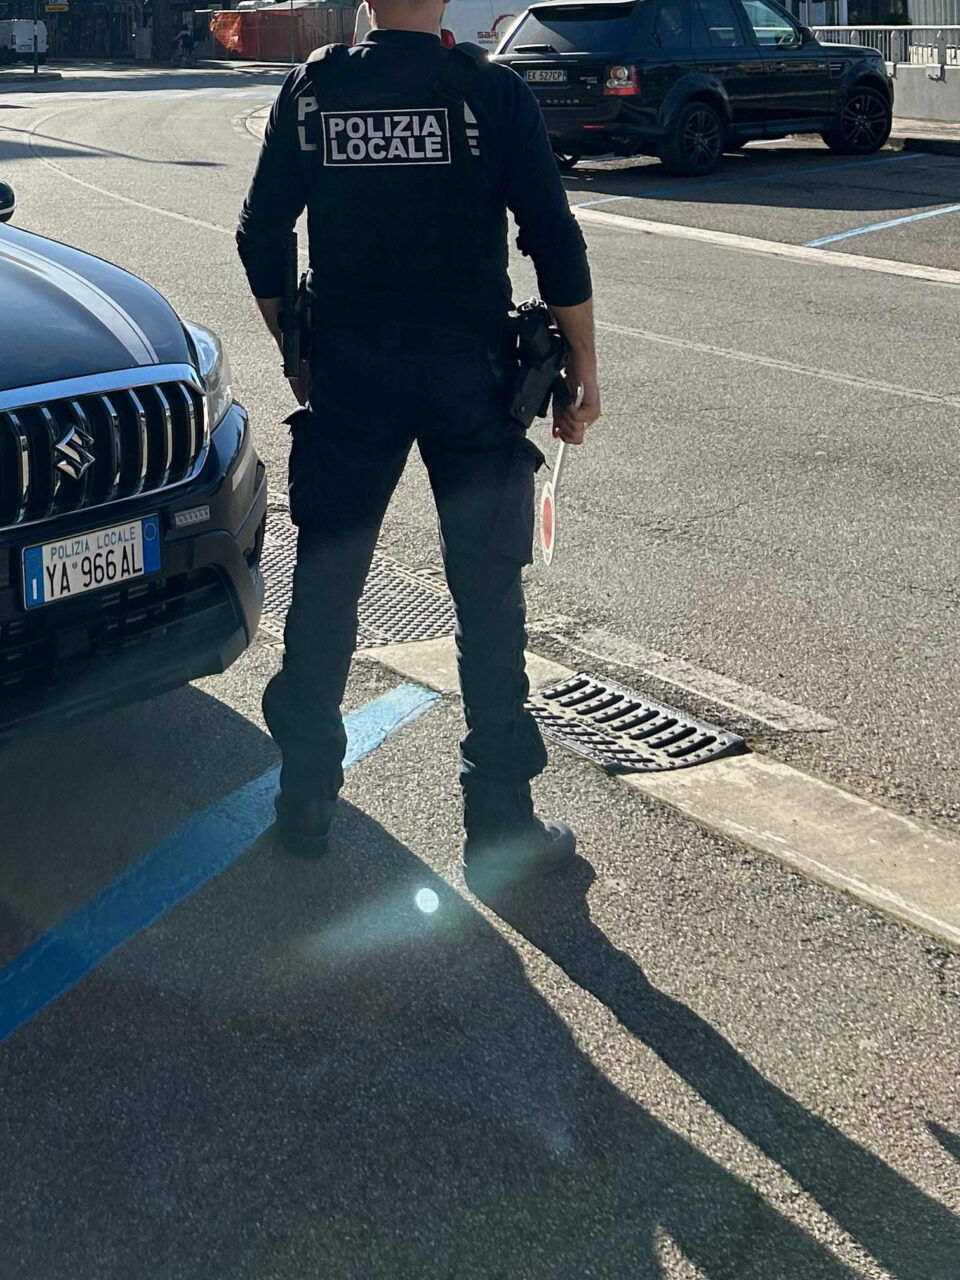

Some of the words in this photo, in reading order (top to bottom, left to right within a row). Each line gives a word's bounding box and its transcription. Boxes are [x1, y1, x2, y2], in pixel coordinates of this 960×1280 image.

[328, 115, 442, 138] POLIZIA
[331, 137, 443, 160] LOCALE
[50, 541, 91, 562] POLIZIA
[96, 526, 137, 549] LOCALE
[46, 562, 71, 598] YA
